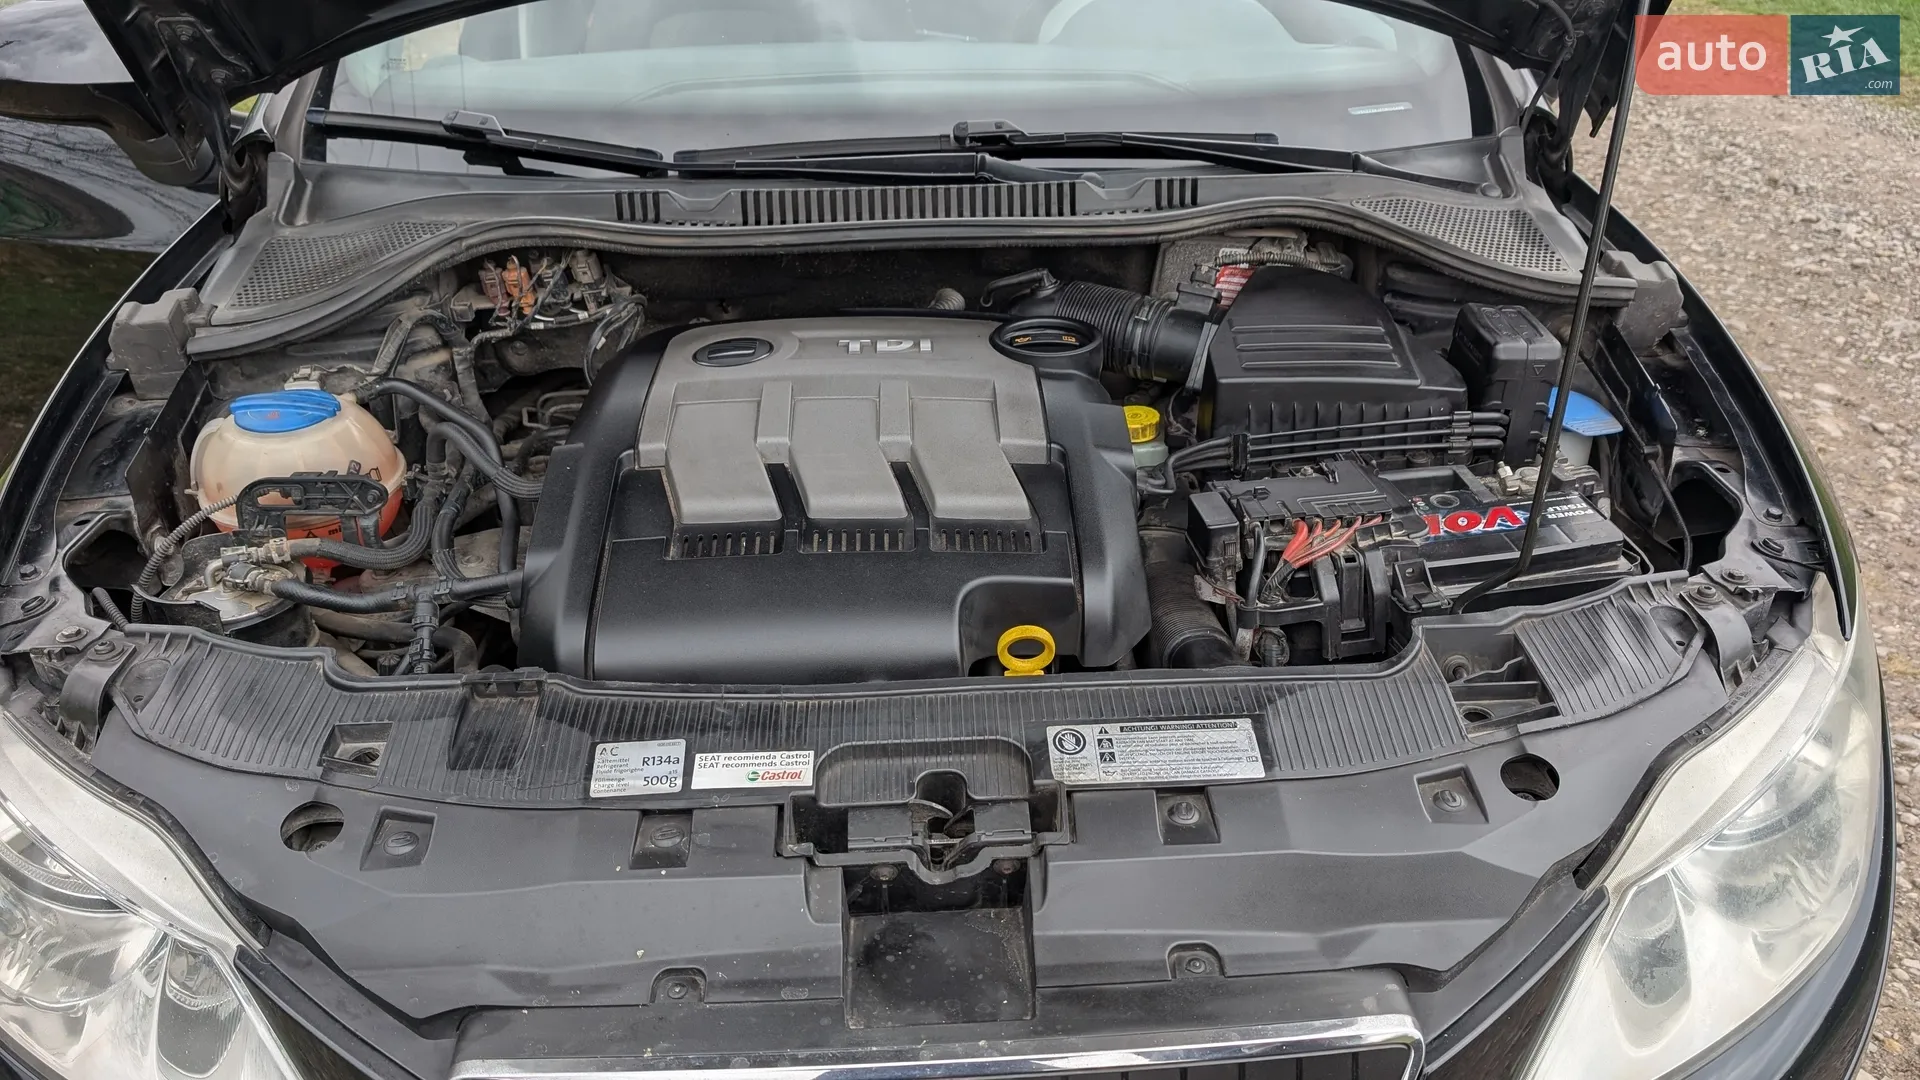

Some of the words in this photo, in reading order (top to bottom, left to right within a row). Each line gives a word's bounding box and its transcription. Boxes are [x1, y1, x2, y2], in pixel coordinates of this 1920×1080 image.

[838, 339, 932, 354] TDI
[1545, 502, 1588, 513] ITSELF
[1546, 508, 1594, 519] POWER
[641, 755, 680, 766] R134a
[723, 753, 777, 761] recomienda
[721, 760, 777, 769] recommends
[779, 759, 810, 767] Castrol
[642, 774, 678, 788] 500g
[760, 770, 803, 781] Castrol
